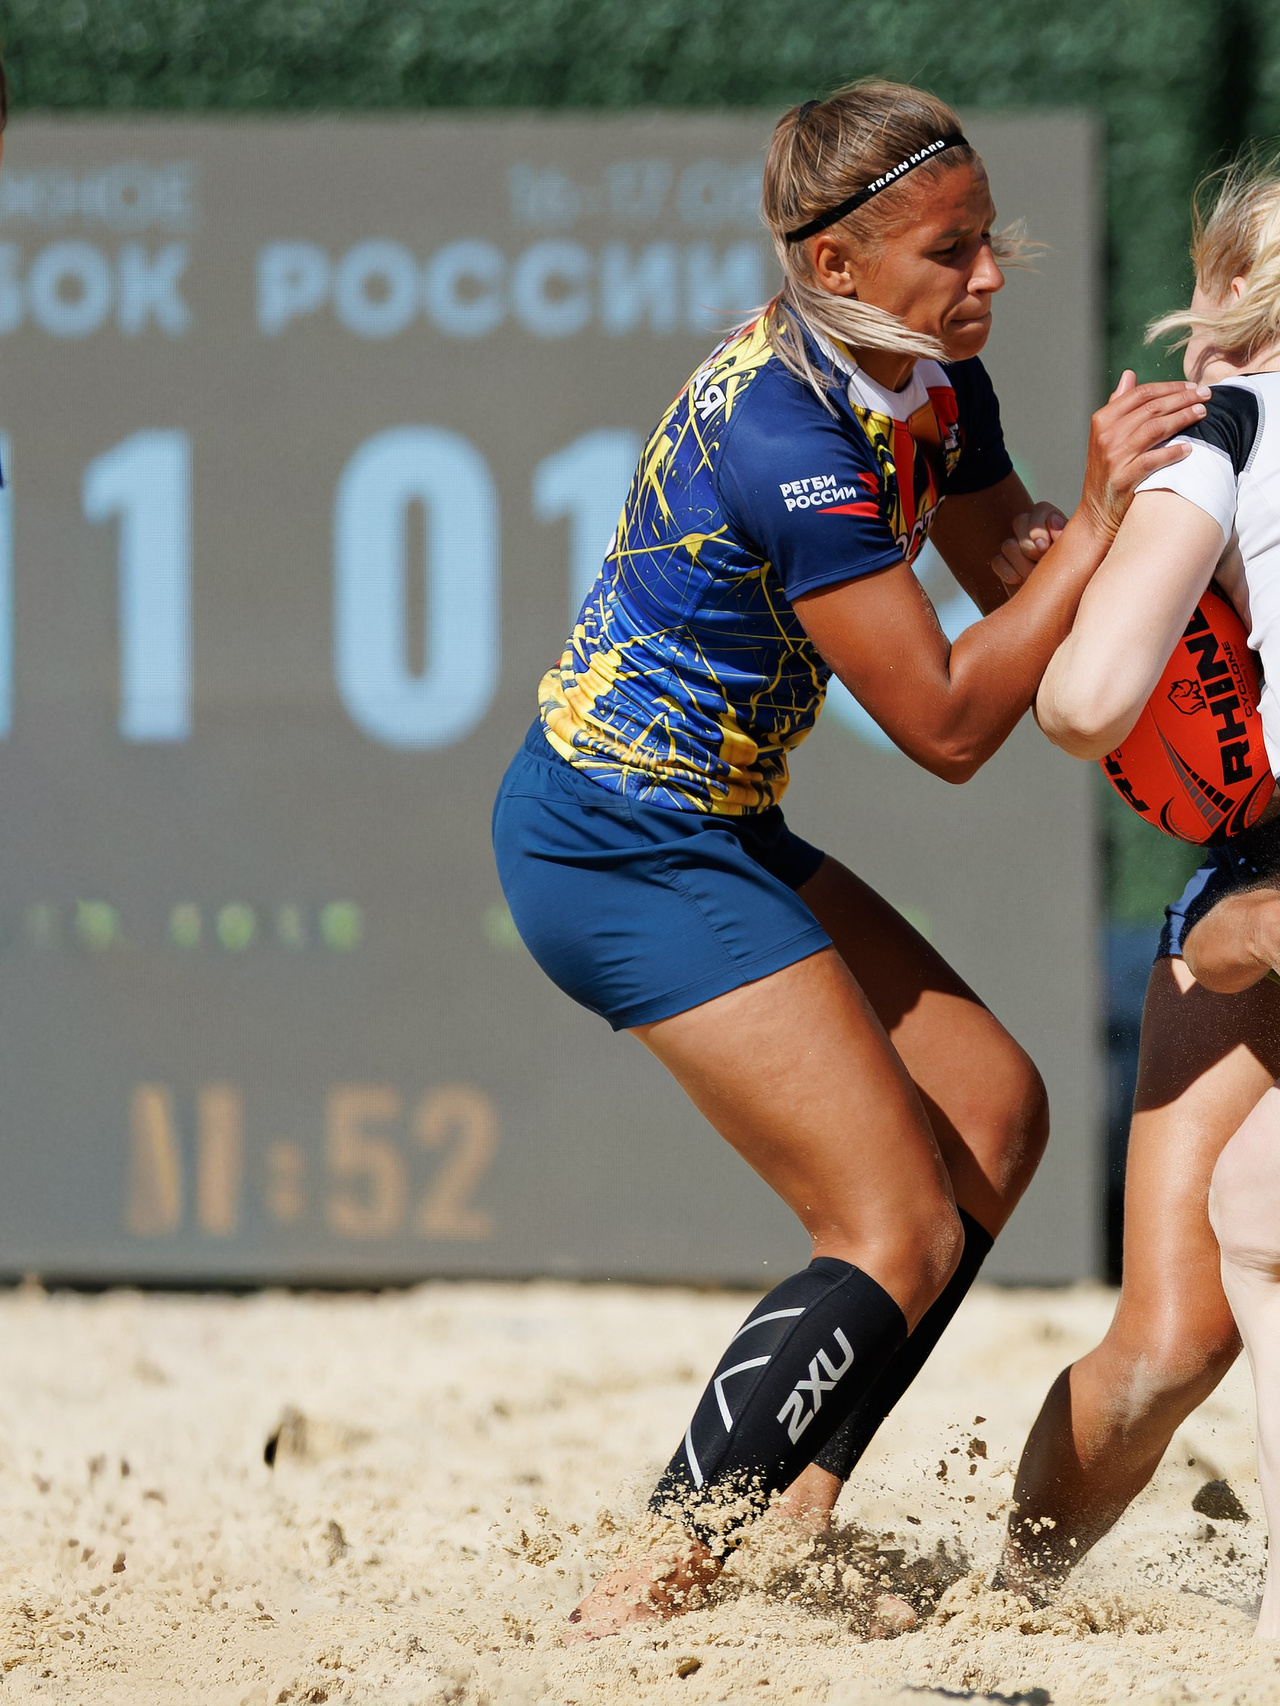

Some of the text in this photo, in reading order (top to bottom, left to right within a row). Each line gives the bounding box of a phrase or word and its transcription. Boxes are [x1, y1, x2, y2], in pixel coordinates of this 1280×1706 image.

[868, 140, 945, 192] TRAIN HARD
[257, 238, 764, 339] РОССИИ
[779, 474, 837, 498] РЕГБИ
[784, 486, 857, 512] РОССИИ
[1221, 641, 1253, 717] CYCLONE
[776, 1326, 854, 1445] 2XU
